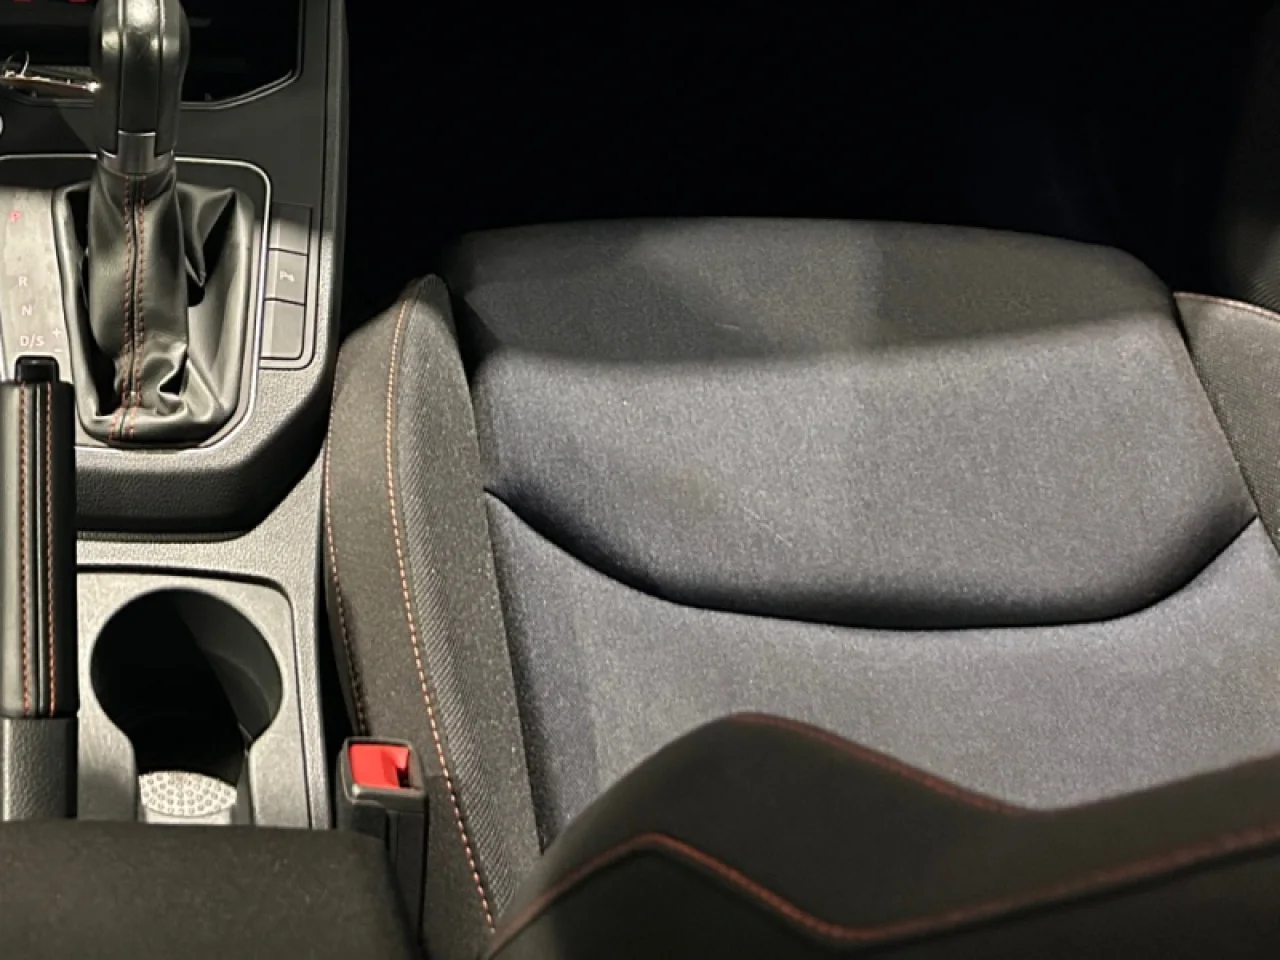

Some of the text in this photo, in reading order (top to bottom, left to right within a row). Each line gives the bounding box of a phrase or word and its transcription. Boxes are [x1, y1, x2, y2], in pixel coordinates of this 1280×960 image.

[18, 276, 28, 287] R
[21, 304, 33, 316] N
[20, 334, 44, 348] D/S
